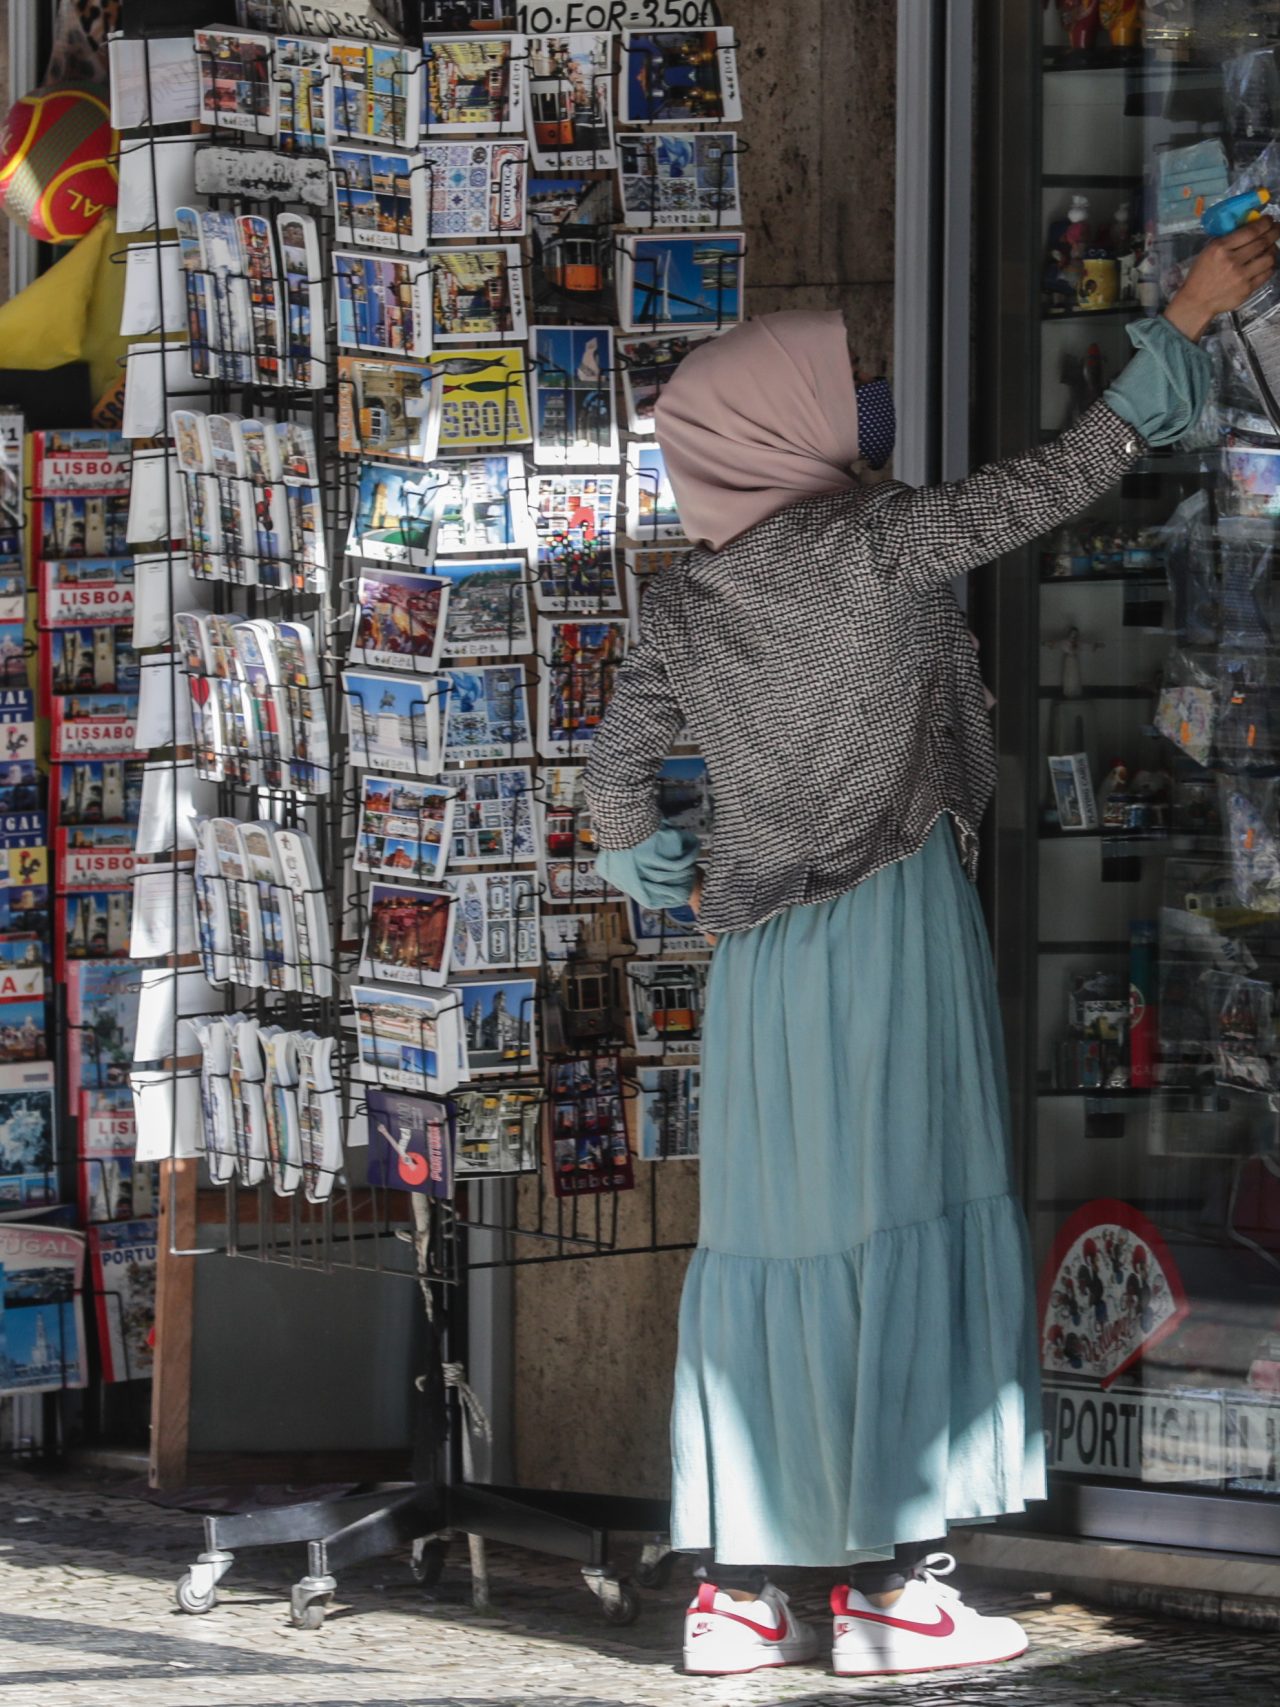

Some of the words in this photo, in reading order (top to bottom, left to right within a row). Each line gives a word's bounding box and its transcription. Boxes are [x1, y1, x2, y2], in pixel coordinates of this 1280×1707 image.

[518, 5, 552, 34] 10
[567, 0, 623, 32] FOR
[443, 400, 524, 439] SBOA
[53, 461, 126, 475] LISBOA
[61, 591, 133, 605] LISBOA
[103, 1247, 156, 1266] PORTU
[1057, 1397, 1218, 1473] PORTUGAL
